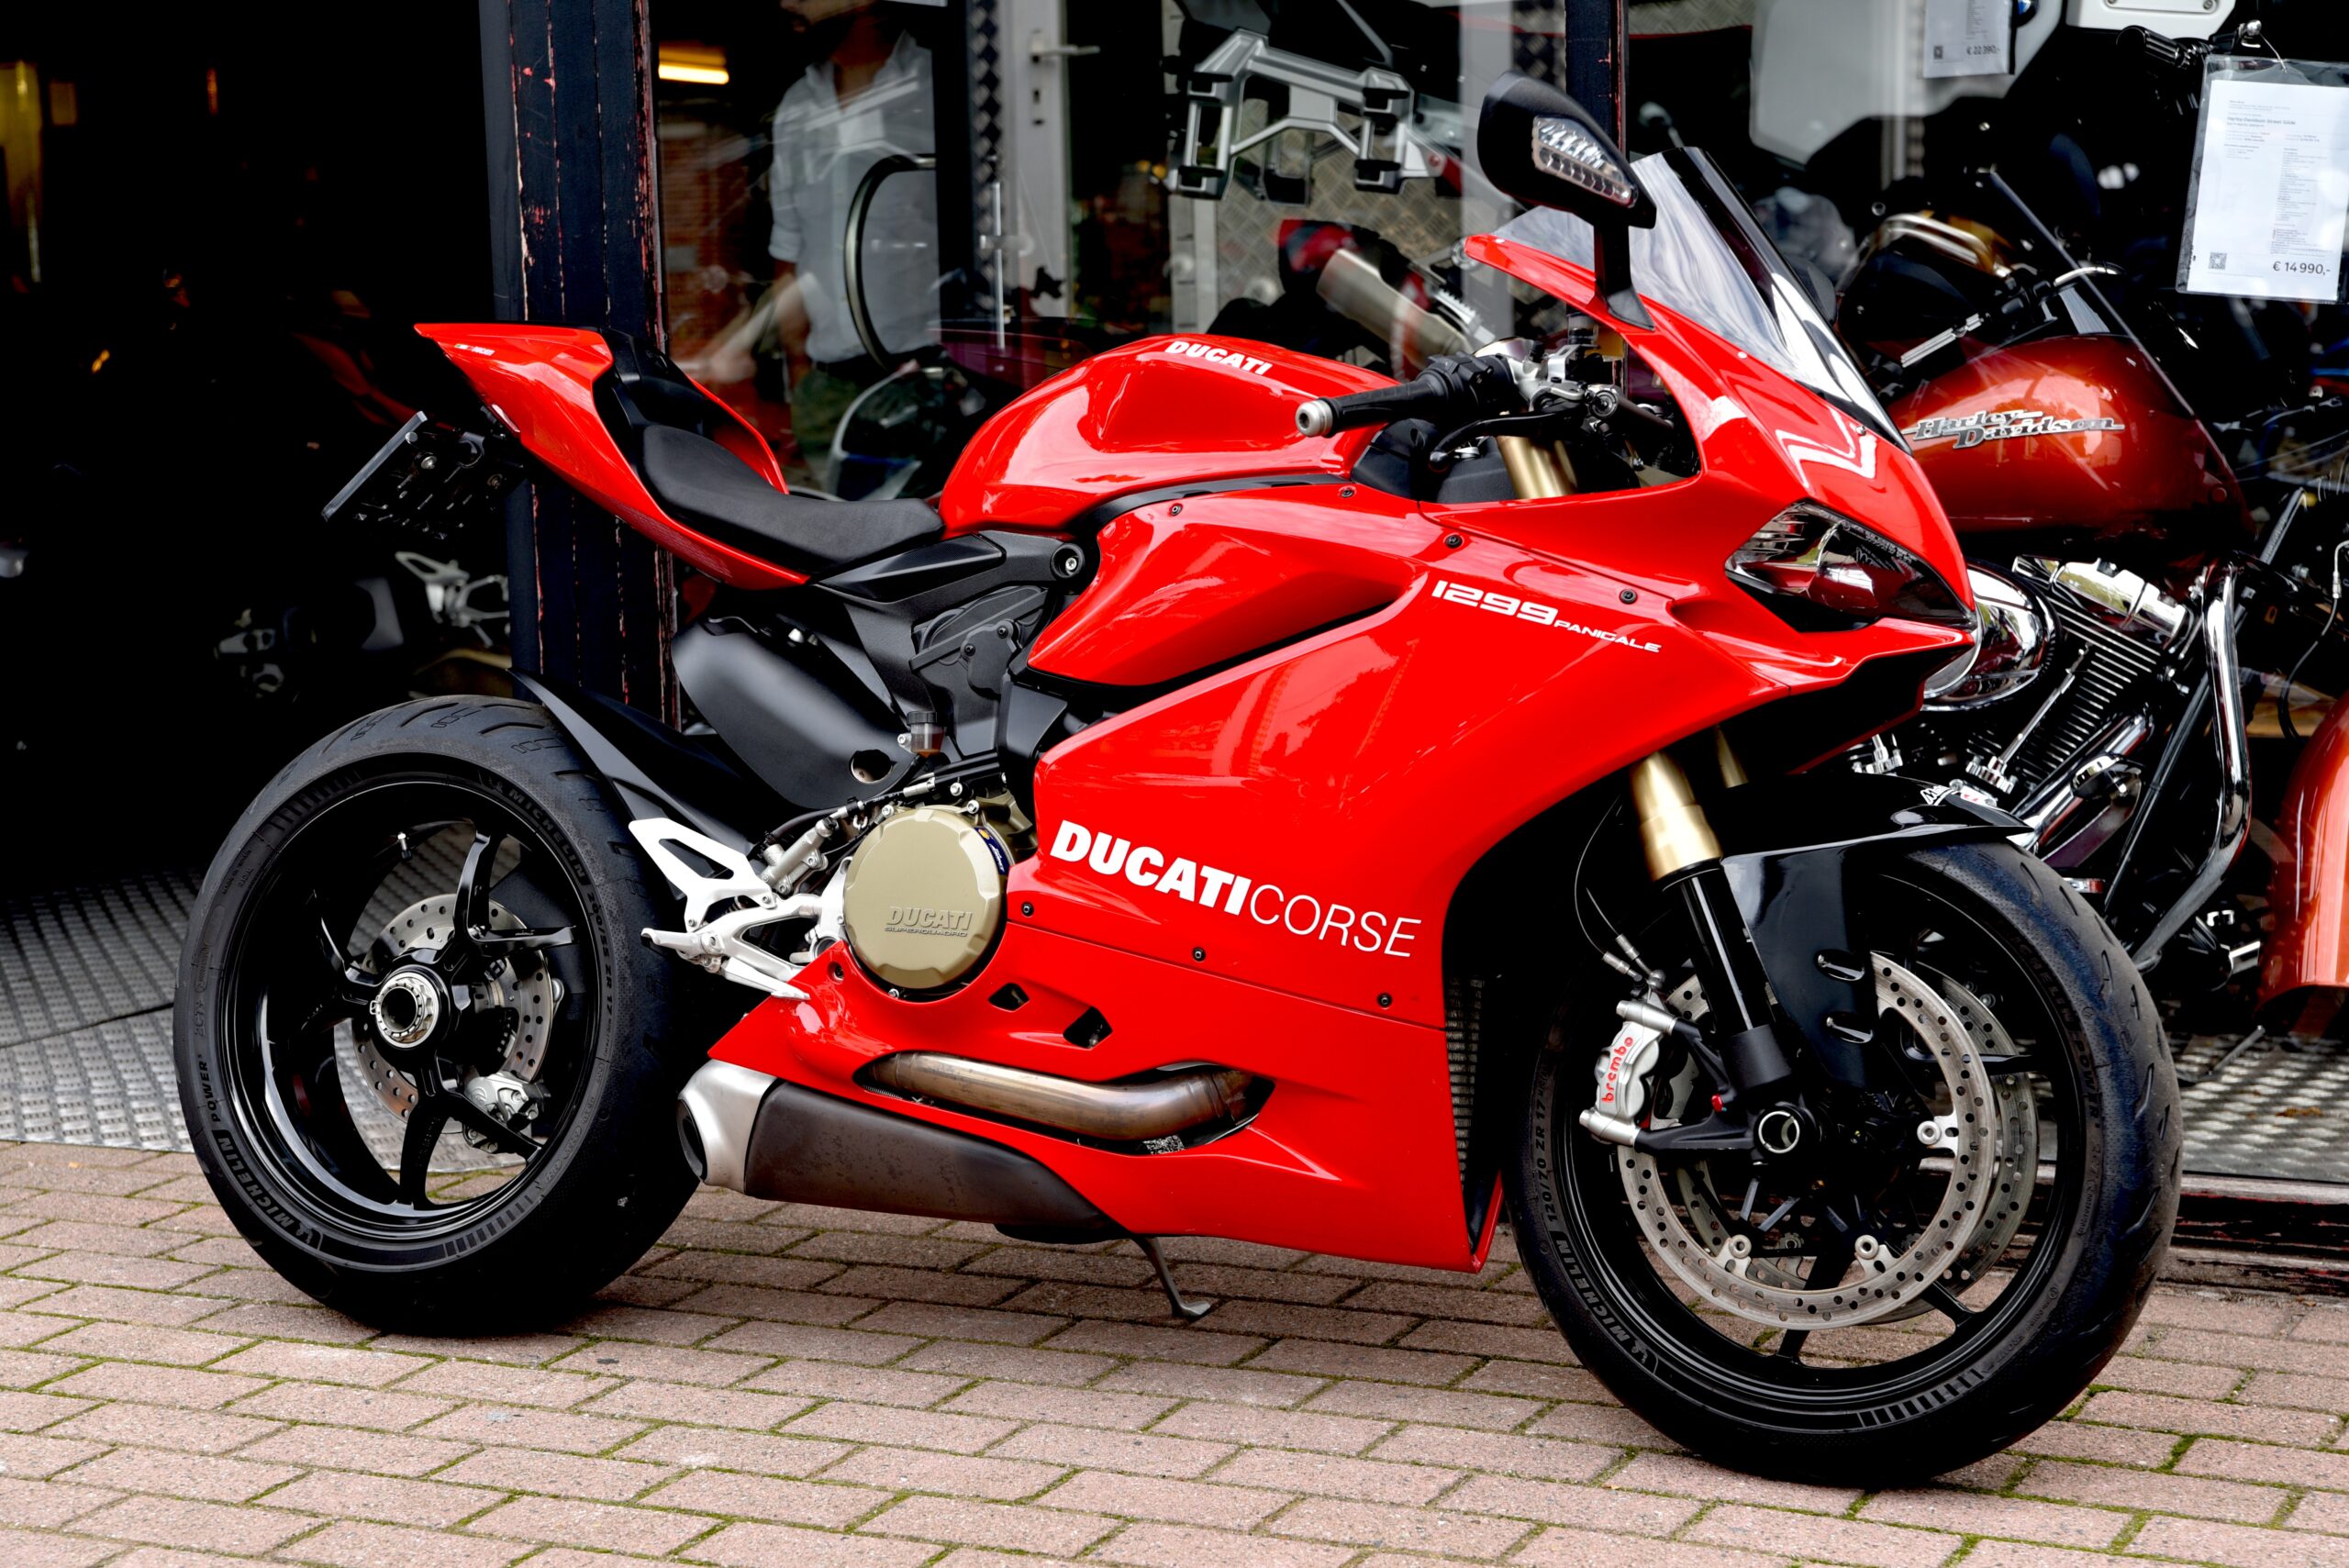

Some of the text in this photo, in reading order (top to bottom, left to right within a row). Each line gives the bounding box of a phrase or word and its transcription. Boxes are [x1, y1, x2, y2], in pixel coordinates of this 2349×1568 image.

[2273, 261, 2281, 272] €
[1163, 340, 1273, 375] DUCATI
[1904, 410, 2043, 441] Harley
[1945, 416, 2125, 450] Davidson
[1431, 580, 1662, 653] 1299 PANIGALE
[508, 788, 586, 879] MICHELIN
[1050, 819, 1421, 958] DUCATI CORSE
[884, 926, 969, 938] SUPERQUADRO
[886, 906, 974, 931] DUCATI
[198, 1061, 221, 1123] POWER
[1601, 1037, 1634, 1103] brembo
[1535, 1099, 1545, 1120] 17
[1534, 1125, 1545, 1150] ZR
[217, 1136, 295, 1233] MICHELIN
[1537, 1158, 1559, 1223] 120/70
[1554, 1238, 1631, 1342] MICHELIN
